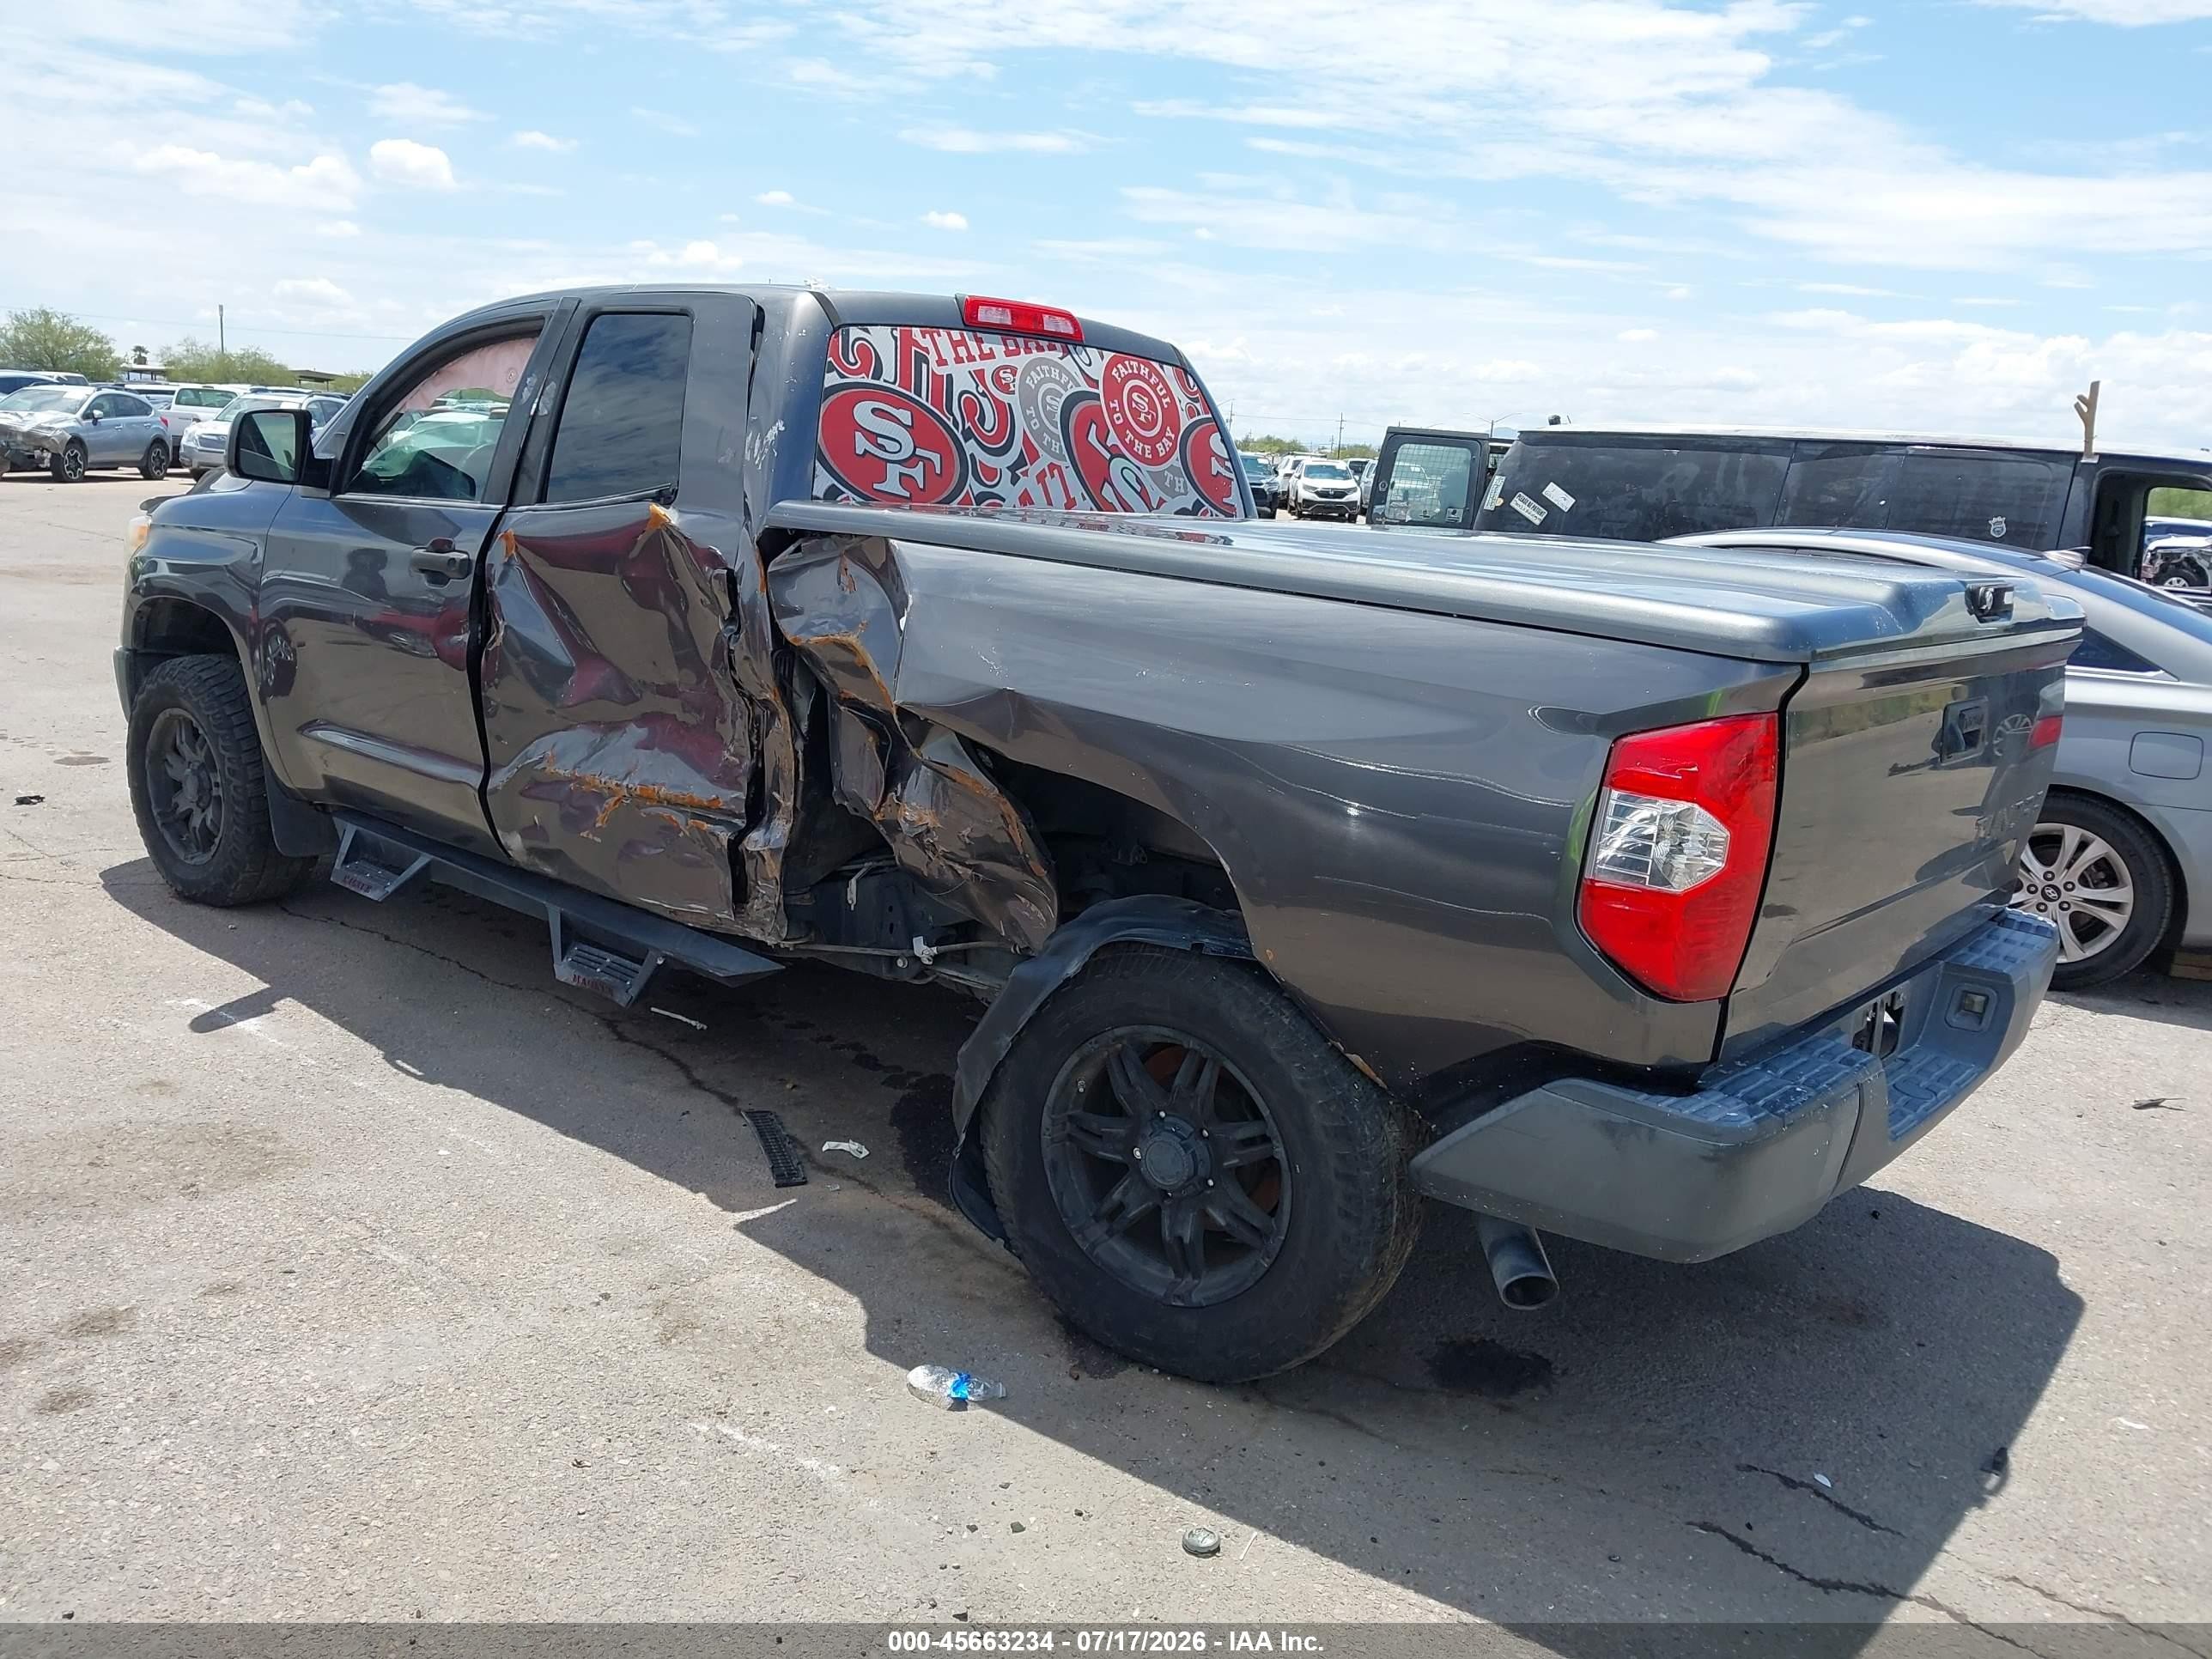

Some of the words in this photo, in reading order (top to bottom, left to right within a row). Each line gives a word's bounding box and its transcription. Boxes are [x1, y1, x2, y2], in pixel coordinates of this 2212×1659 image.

[920, 330, 996, 367] THE
[1111, 360, 1170, 408] FAITHFUL
[1109, 399, 1124, 424] TO
[1132, 392, 1157, 423] SF
[1026, 406, 1040, 429] TO
[1042, 432, 1061, 454] TH
[1125, 429, 1152, 459] THE
[1156, 425, 1175, 457] BAY
[853, 400, 941, 498] SF
[1164, 470, 1185, 493] TH
